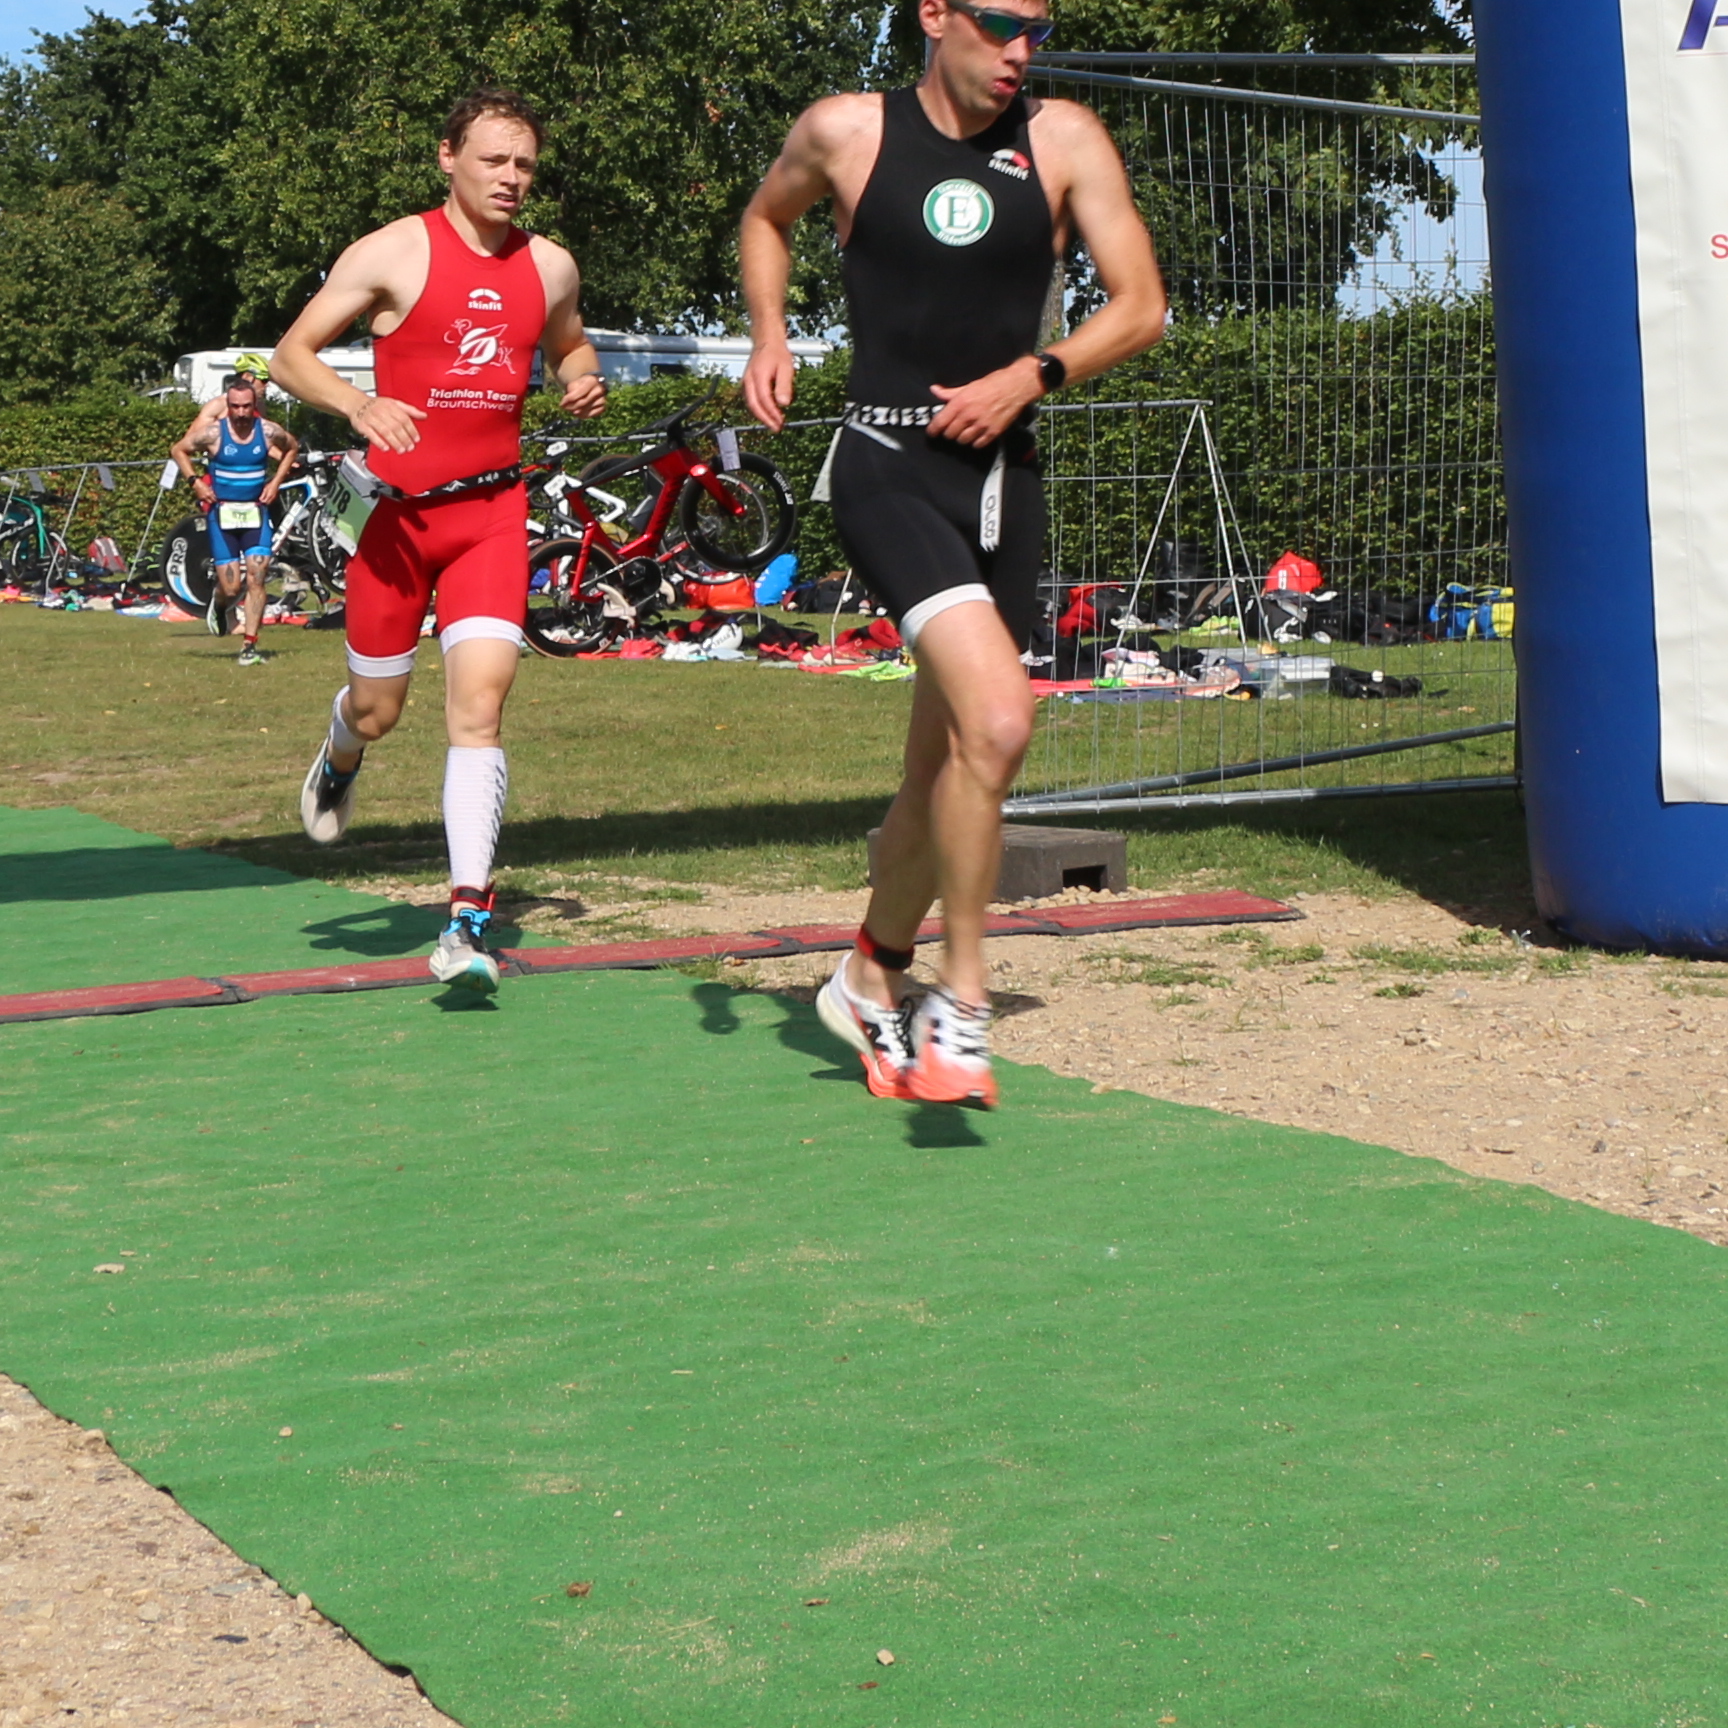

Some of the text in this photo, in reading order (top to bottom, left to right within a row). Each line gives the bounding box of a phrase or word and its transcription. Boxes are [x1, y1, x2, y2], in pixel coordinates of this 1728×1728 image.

[945, 195, 972, 229] E
[468, 301, 503, 311] skinfit
[430, 388, 517, 402] Triathlon Team
[426, 398, 515, 412] Braunschweig
